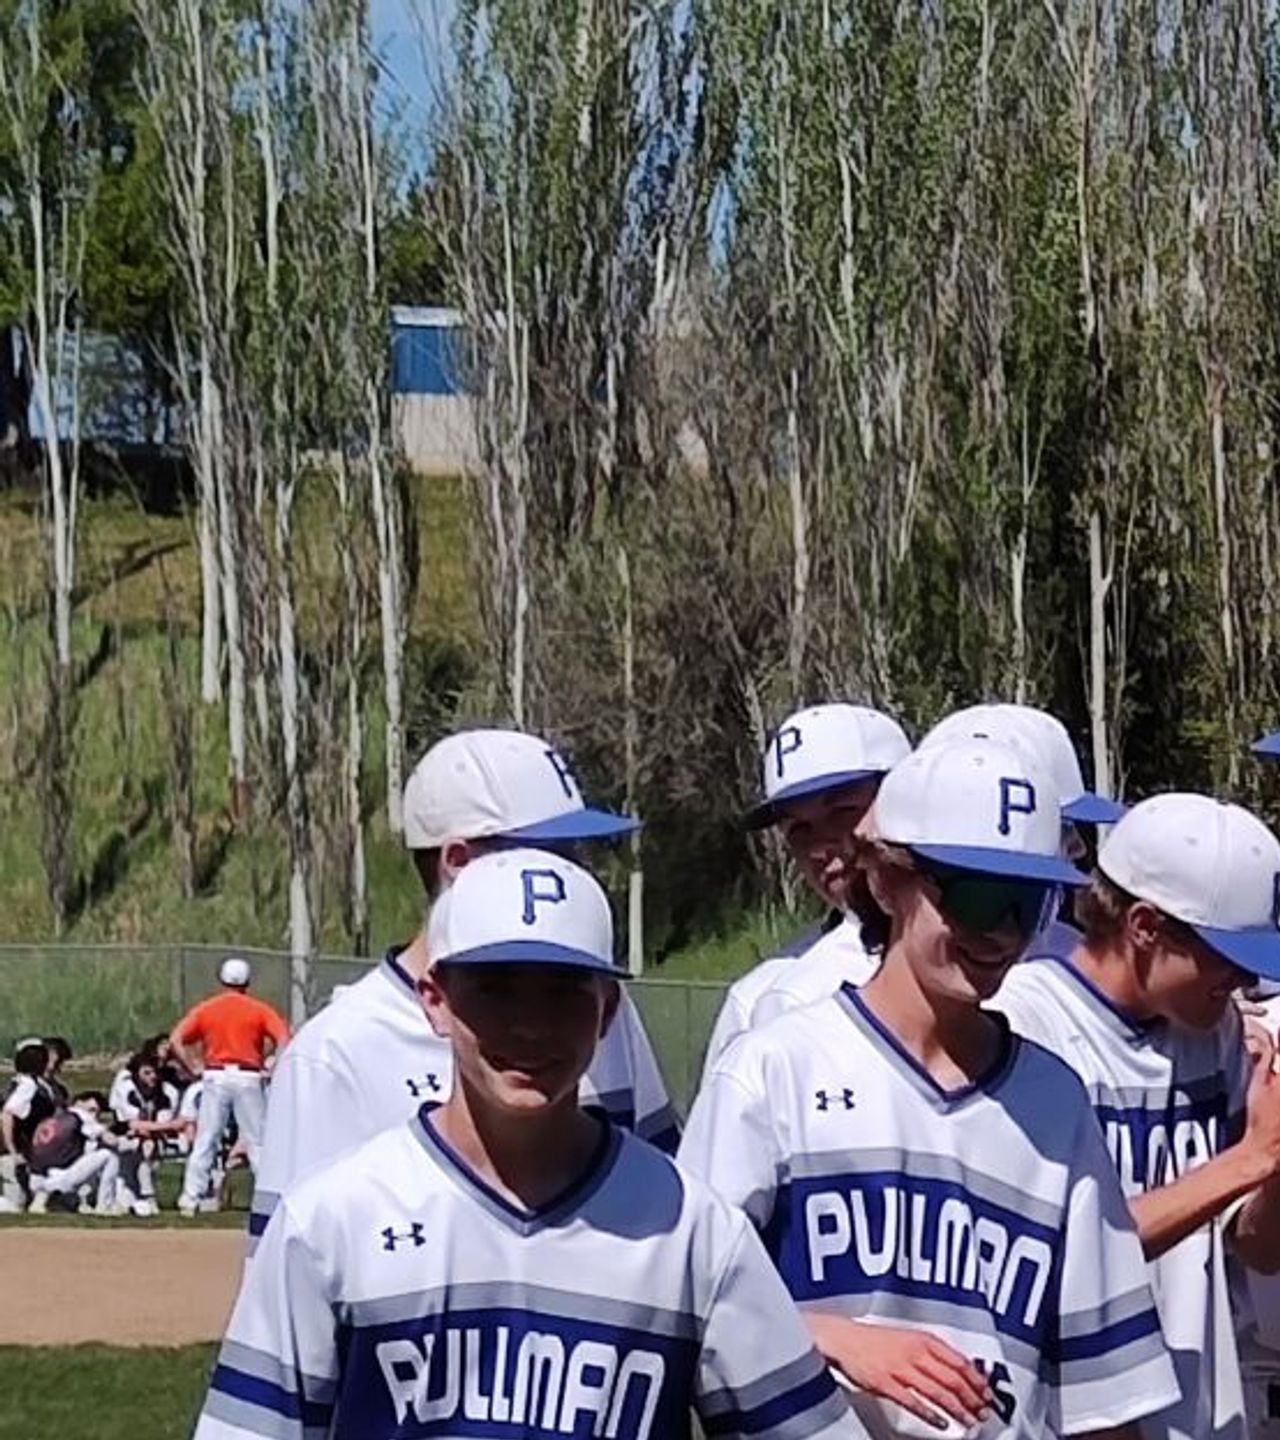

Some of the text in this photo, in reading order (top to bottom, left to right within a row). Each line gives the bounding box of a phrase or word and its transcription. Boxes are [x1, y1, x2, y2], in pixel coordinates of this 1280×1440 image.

[773, 726, 801, 778] P
[998, 776, 1036, 836] P
[519, 868, 567, 925] P
[804, 1189, 1052, 1328] PULLMAN
